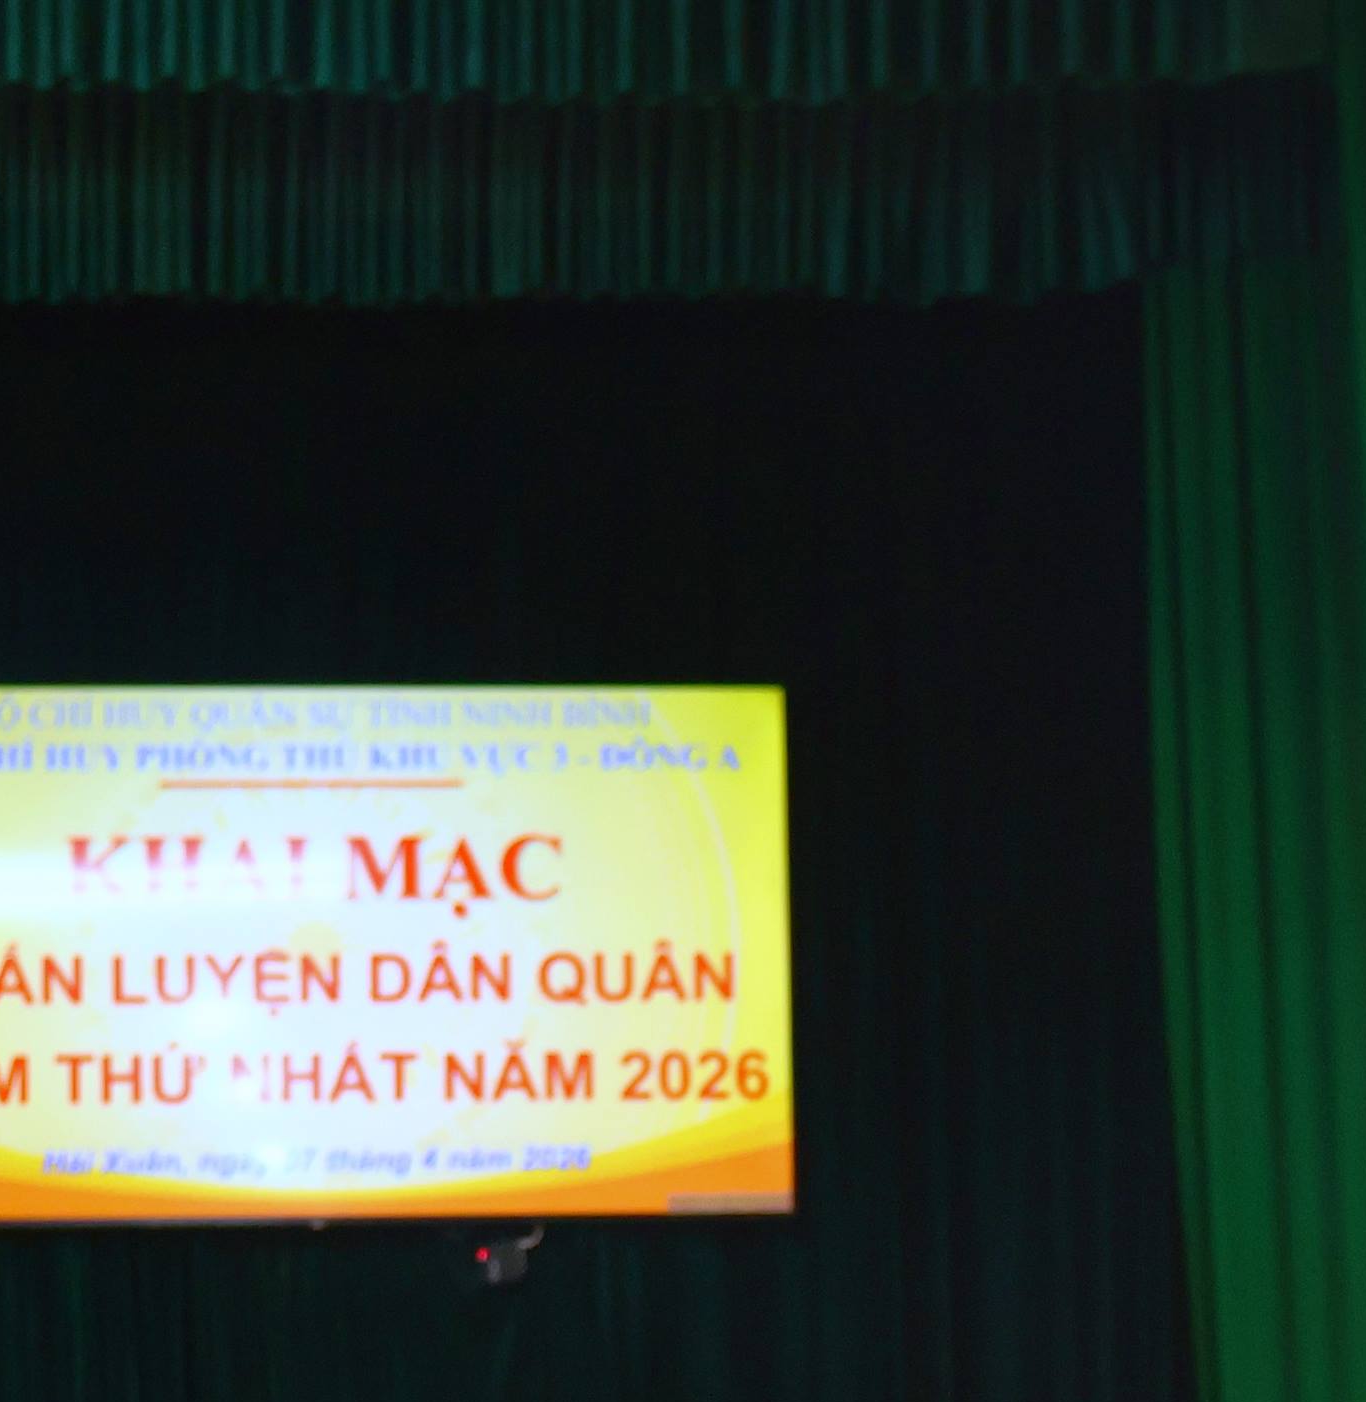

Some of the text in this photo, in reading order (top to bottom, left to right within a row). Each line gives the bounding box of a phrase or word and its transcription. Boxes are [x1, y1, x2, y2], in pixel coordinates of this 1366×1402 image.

[46, 744, 121, 771] HUY
[369, 743, 444, 770] KHU
[718, 744, 741, 771] A
[68, 834, 565, 919] KHAI MẠC
[113, 947, 341, 1018] LUYỆN
[370, 940, 512, 1002] DÂN
[539, 938, 734, 1006] QUÂN
[55, 1041, 207, 1106] THỨ
[444, 1038, 595, 1102] NĂM
[619, 1048, 770, 1102] 2026
